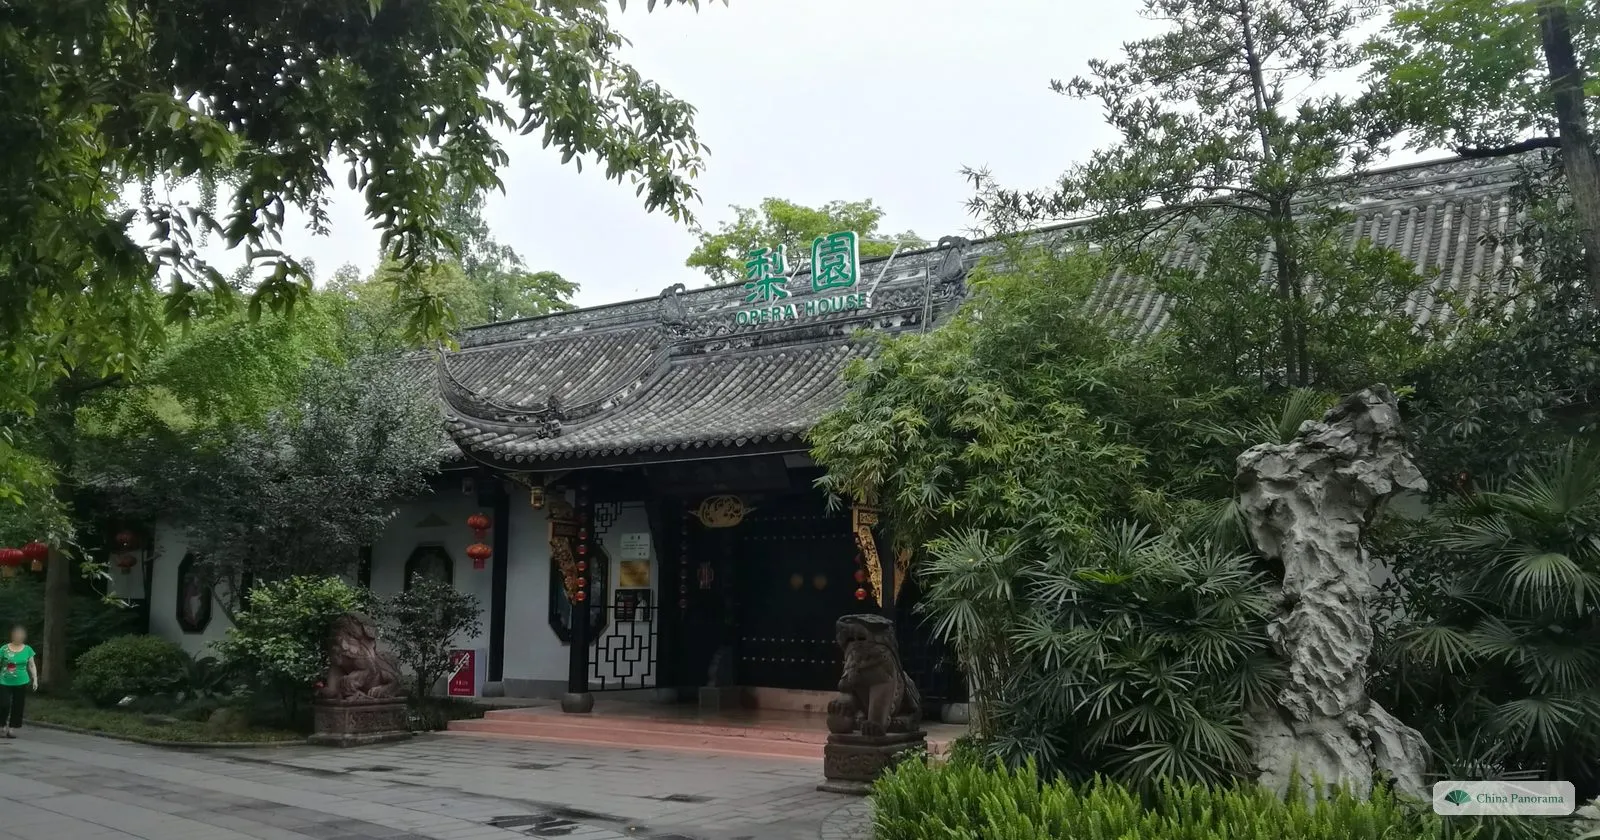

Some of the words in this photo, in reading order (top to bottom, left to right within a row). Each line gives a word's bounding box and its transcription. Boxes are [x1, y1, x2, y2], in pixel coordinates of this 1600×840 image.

[744, 231, 861, 302] 梨園
[736, 305, 798, 326] OPERA
[805, 293, 867, 317] HOUSE
